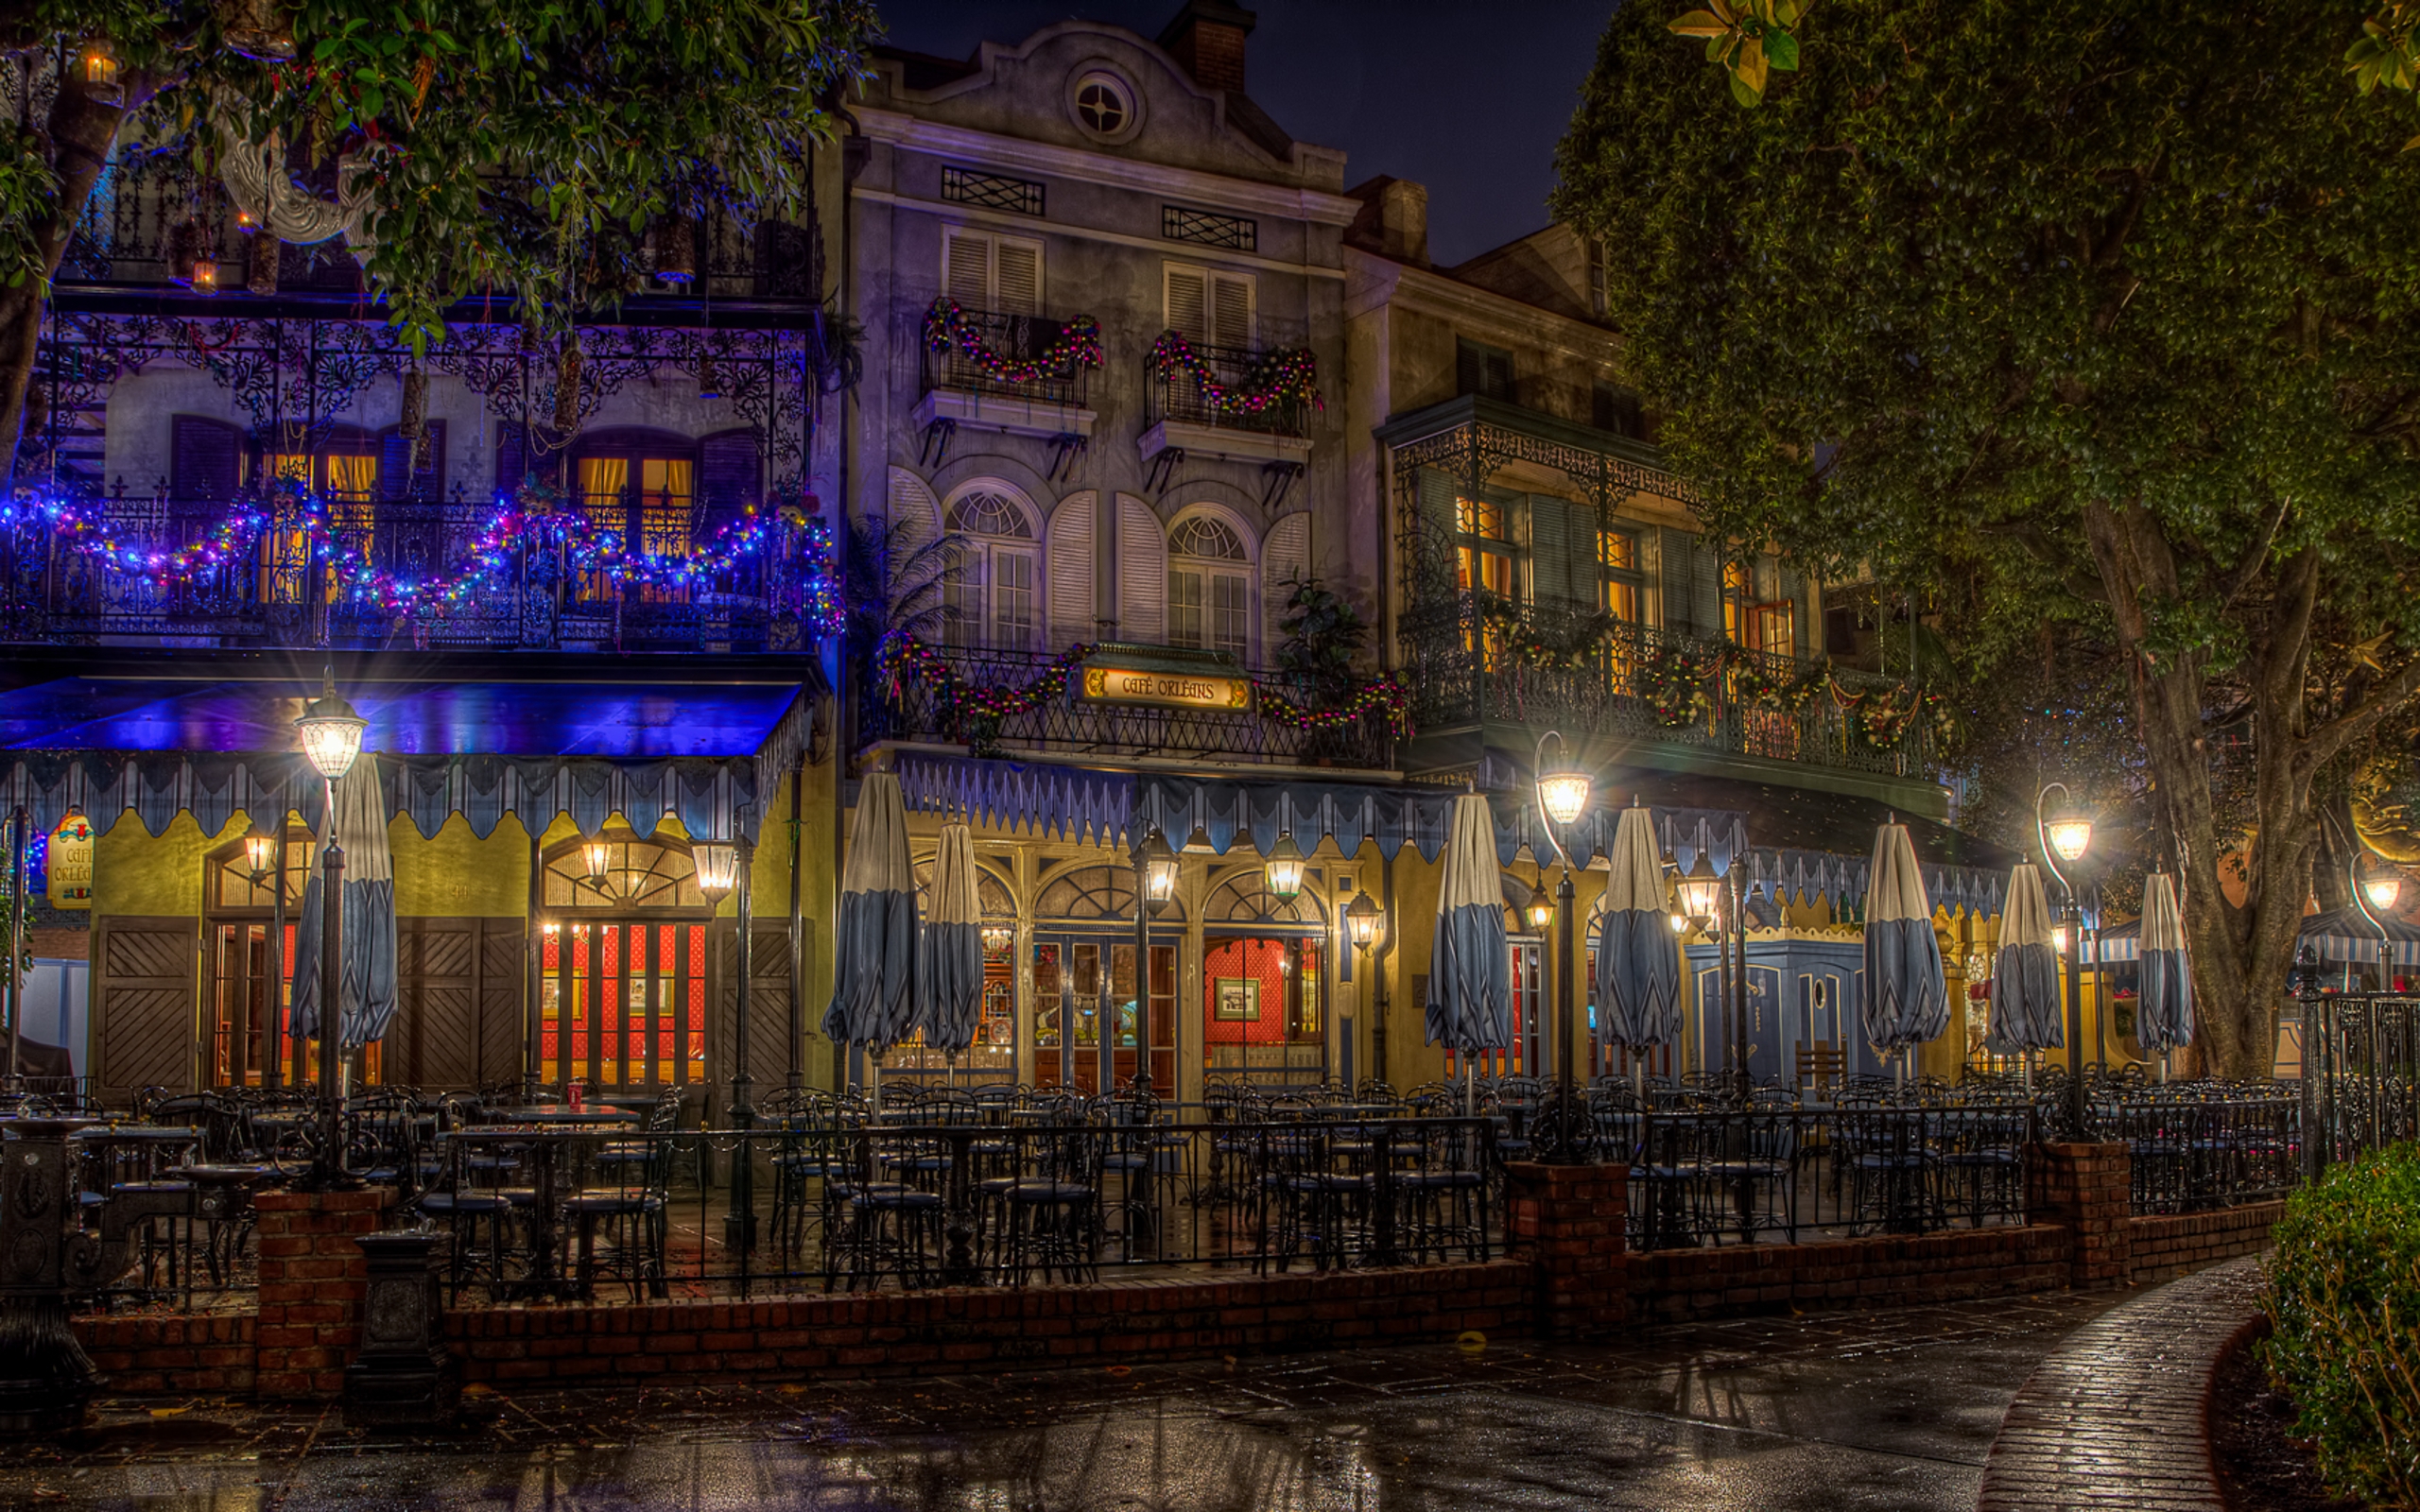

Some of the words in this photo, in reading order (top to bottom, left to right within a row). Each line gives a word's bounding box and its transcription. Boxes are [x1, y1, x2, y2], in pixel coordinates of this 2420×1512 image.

[1123, 676, 1152, 695] CAFÉ
[1158, 679, 1214, 699] ORLÉANS
[55, 866, 91, 882] ORLÉA
